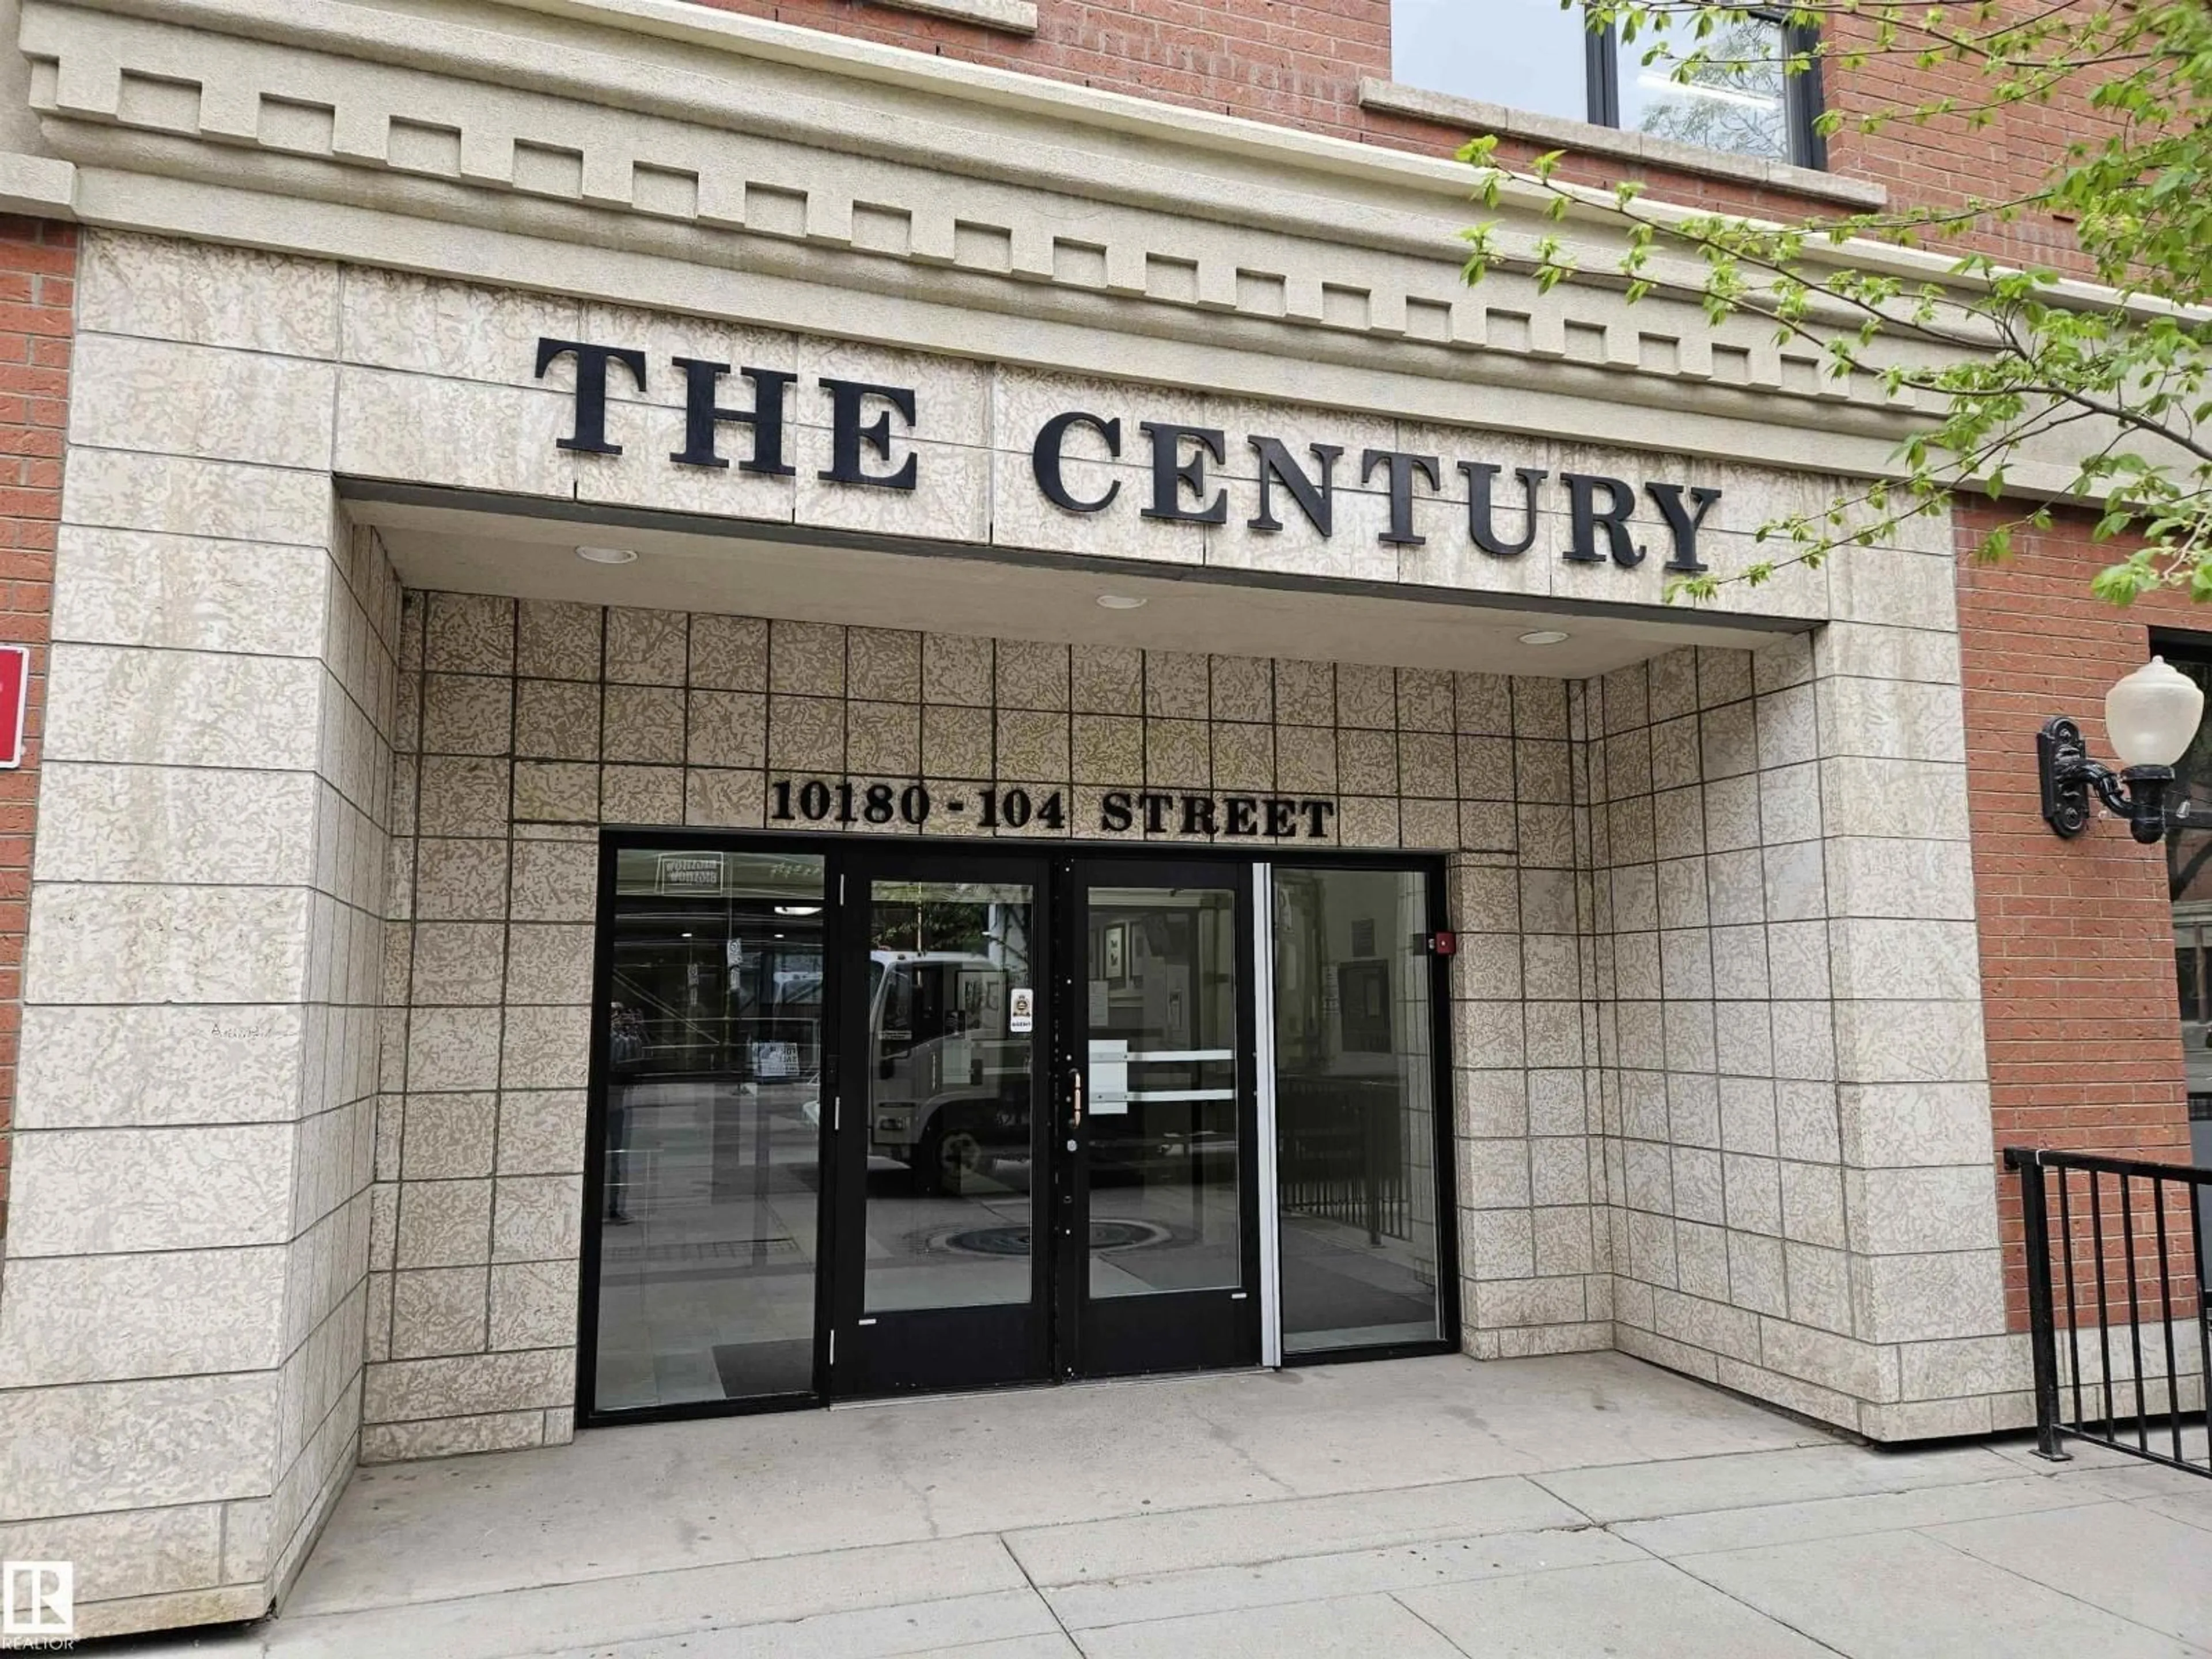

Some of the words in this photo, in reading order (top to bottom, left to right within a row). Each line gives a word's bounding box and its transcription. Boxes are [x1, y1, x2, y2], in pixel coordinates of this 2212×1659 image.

[535, 337, 918, 490] THE
[1032, 411, 1722, 572] CENTURY
[772, 779, 930, 825] 10180
[978, 789, 1065, 830] 104
[1101, 793, 1334, 838] STREET
